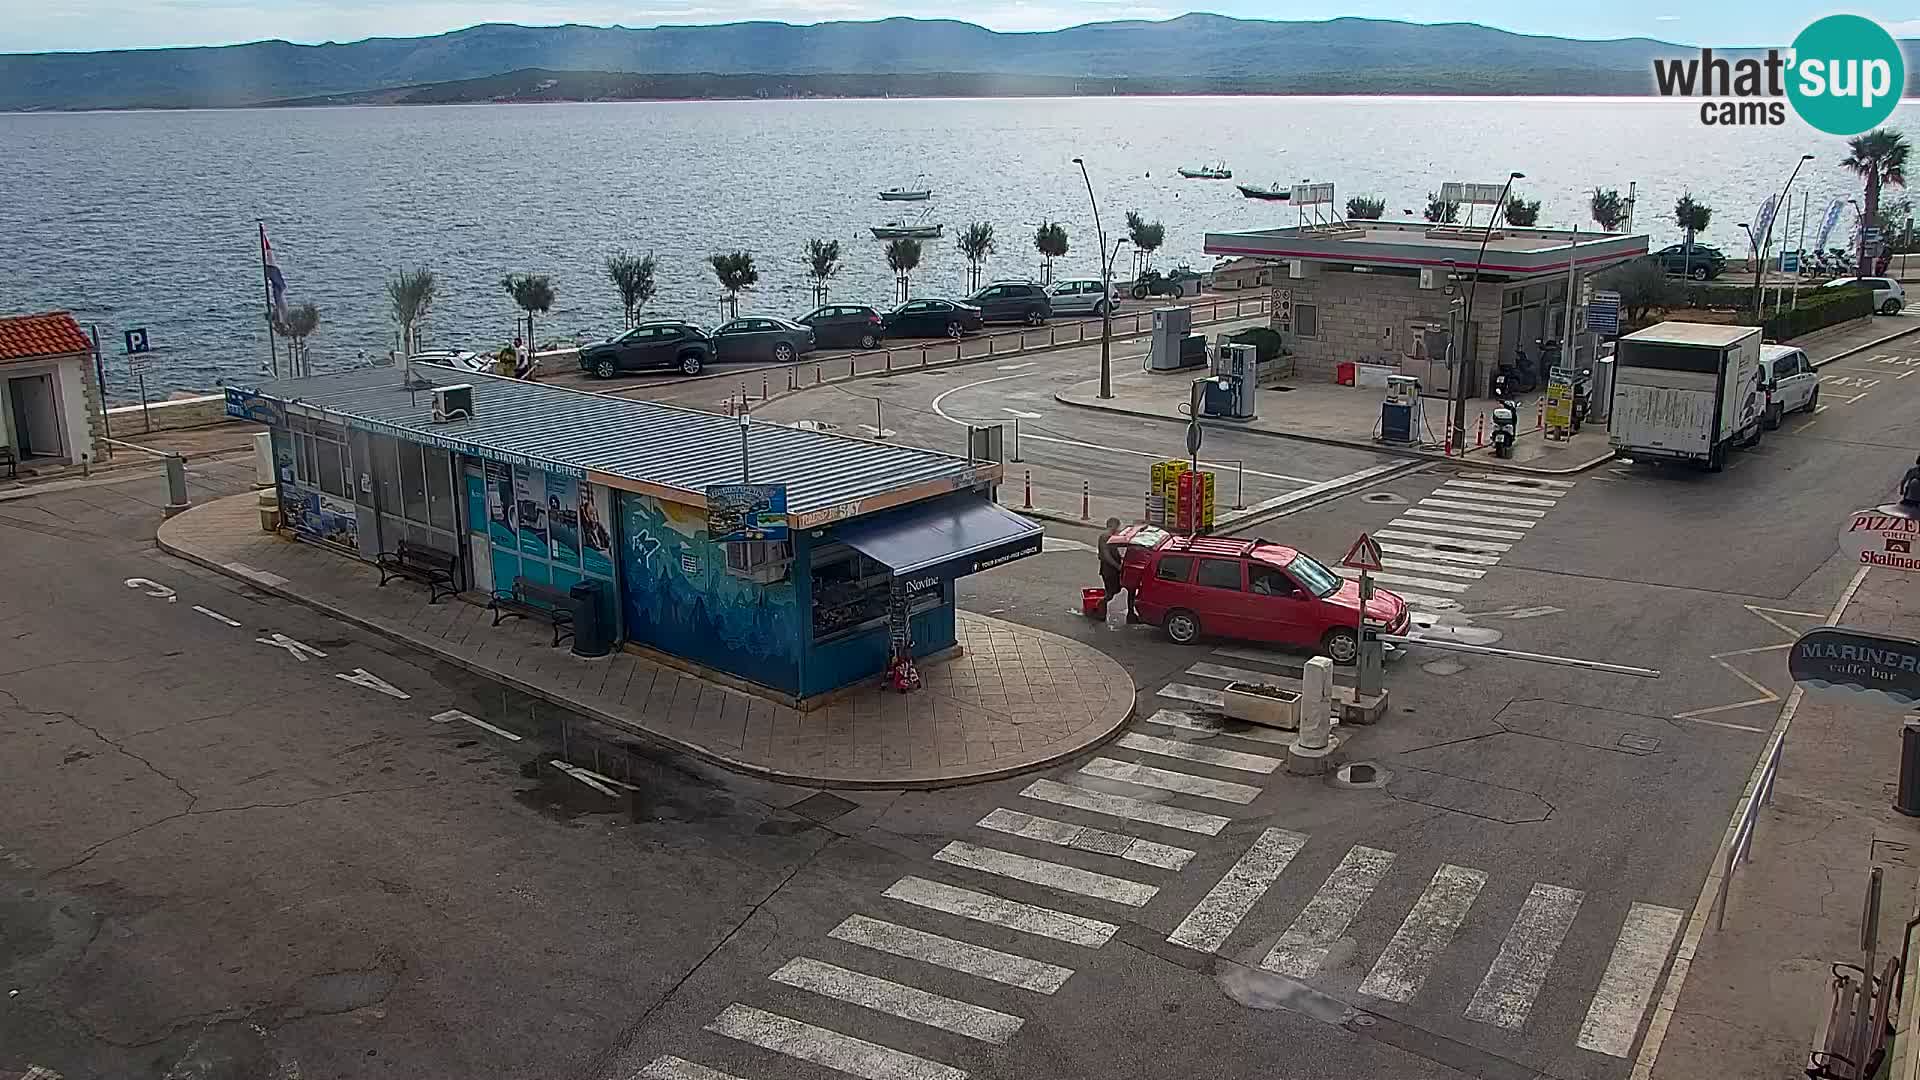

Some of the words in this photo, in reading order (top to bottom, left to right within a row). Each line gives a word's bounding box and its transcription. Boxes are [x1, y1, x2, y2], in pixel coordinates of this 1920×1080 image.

[130, 332, 142, 351] P
[437, 438, 468, 453] POSTAJA
[479, 449, 493, 463] BUS
[494, 453, 526, 468] STATION
[529, 459, 555, 473] TICKET
[555, 465, 583, 478] OFFICE
[1848, 516, 1920, 533] PIZZE
[1830, 664, 1866, 676] caffe
[1871, 667, 1897, 681] bar
